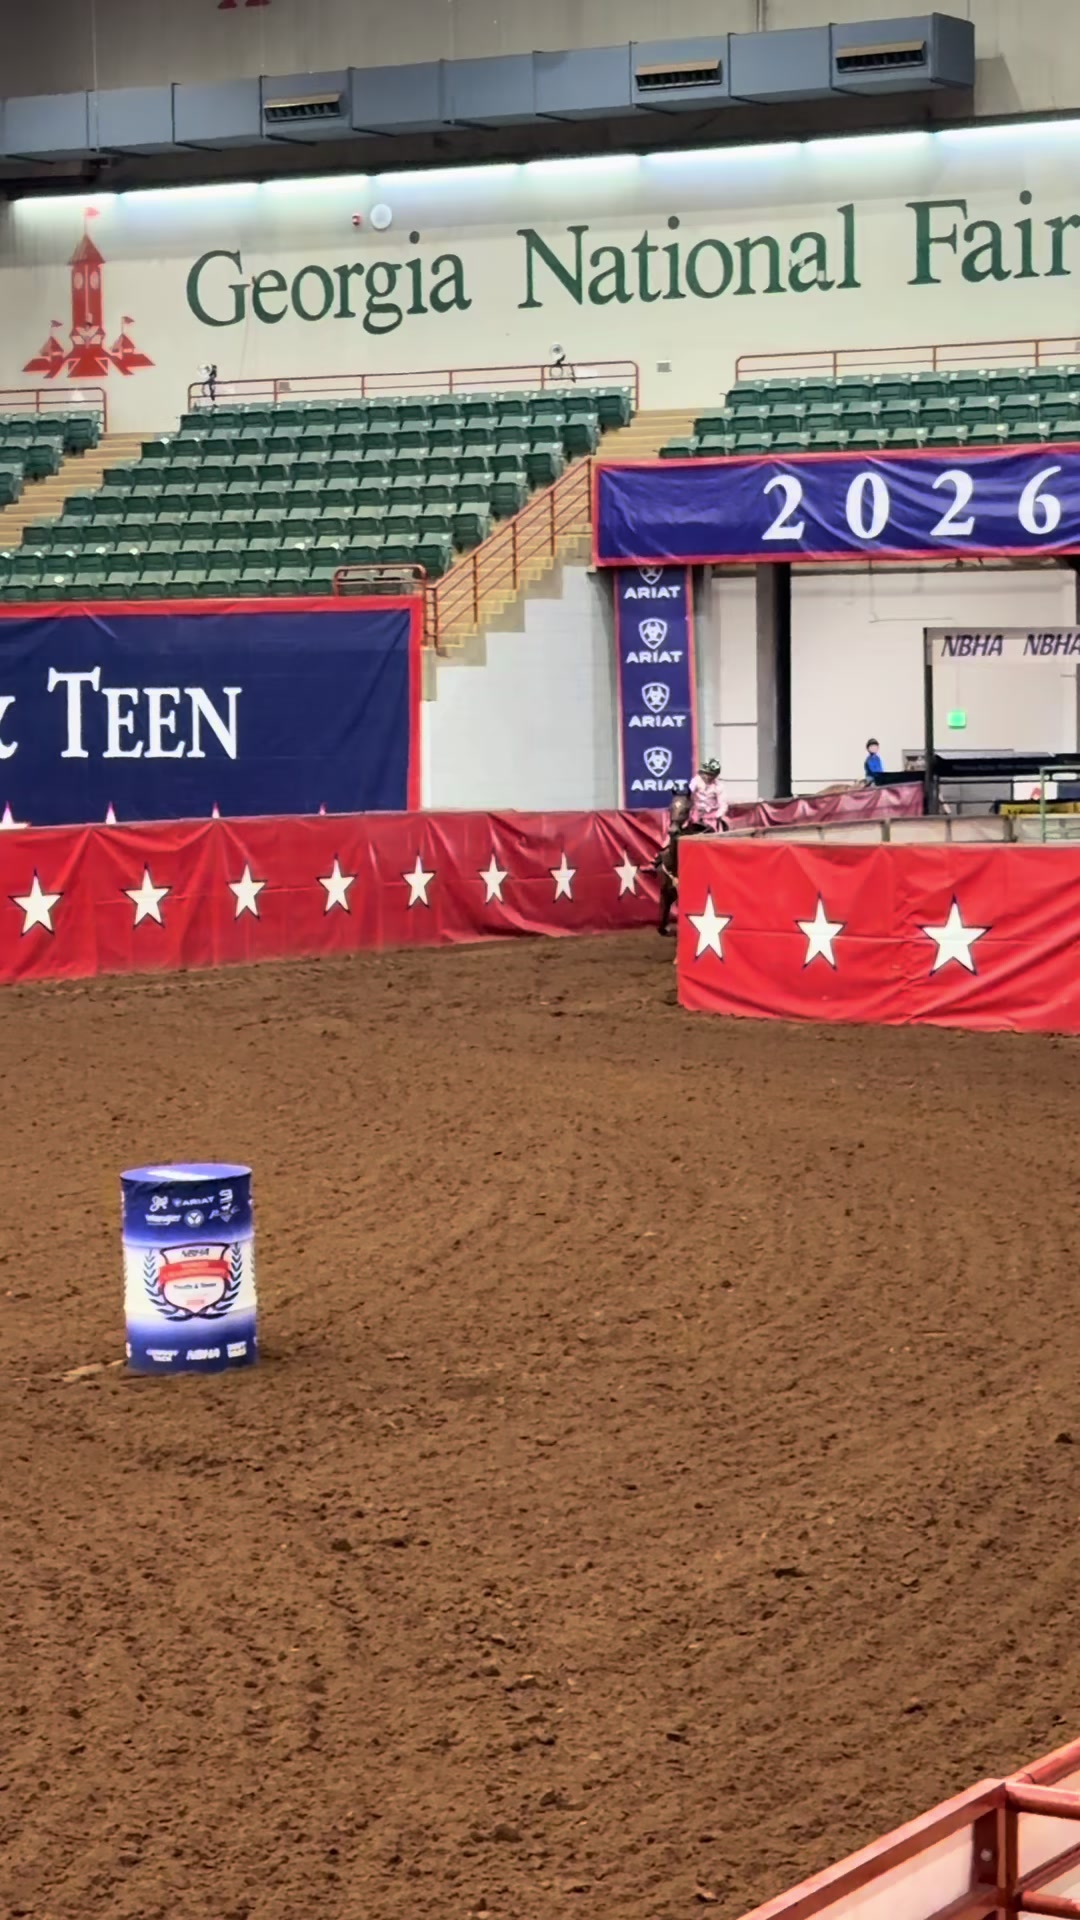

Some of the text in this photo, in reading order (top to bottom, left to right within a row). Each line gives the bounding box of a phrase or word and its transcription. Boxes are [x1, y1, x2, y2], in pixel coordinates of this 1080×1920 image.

[187, 190, 1080, 335] Georgia National Fair
[762, 465, 1062, 540] 2026
[624, 585, 681, 600] ARIAT
[941, 632, 1080, 657] NBHA NBHA
[626, 650, 684, 664] ARIAT
[47, 666, 242, 760] TEEN
[628, 714, 687, 728] ARIAT
[631, 778, 688, 792] ARIAT
